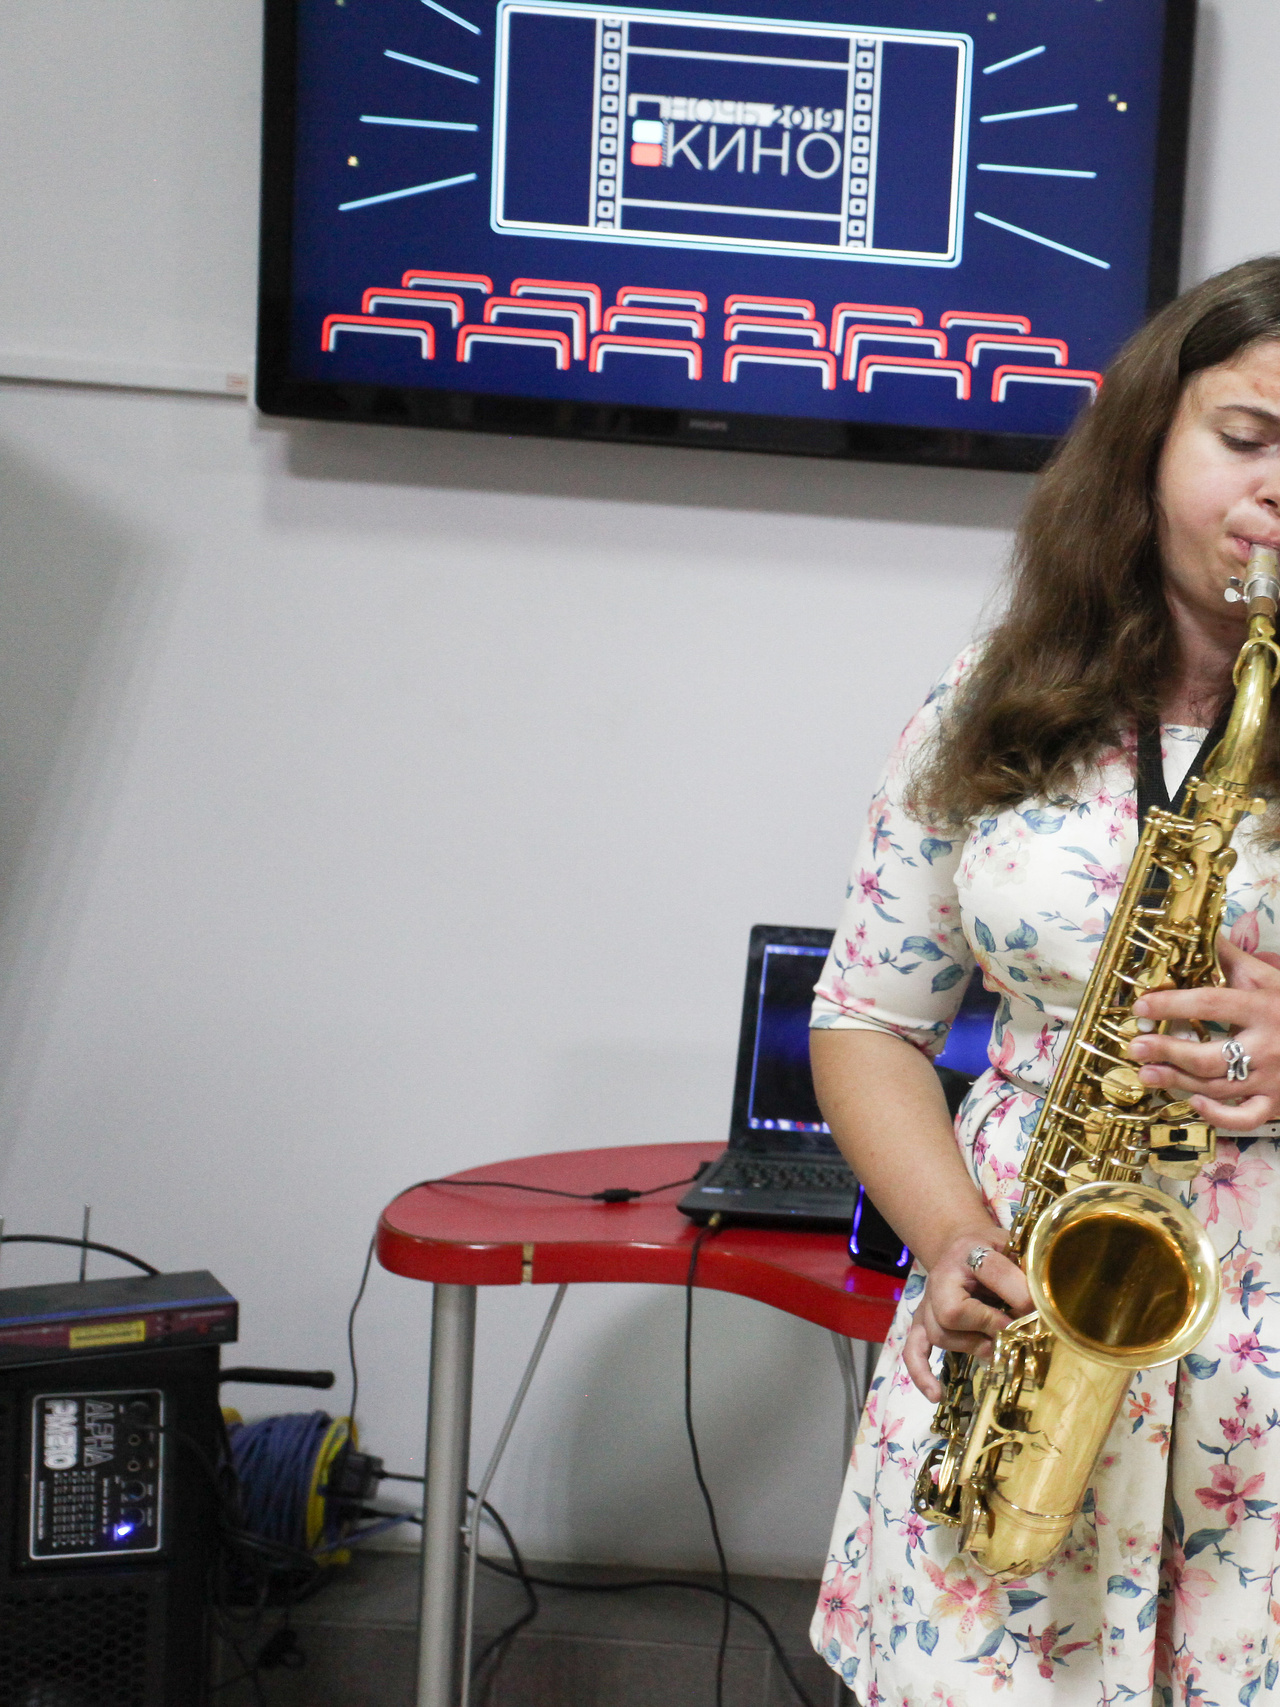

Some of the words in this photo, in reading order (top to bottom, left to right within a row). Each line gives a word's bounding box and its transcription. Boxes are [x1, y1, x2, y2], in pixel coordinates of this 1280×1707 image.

[669, 97, 760, 127] НОЧЬ
[771, 103, 840, 132] 2019
[665, 121, 842, 180] КИНО
[84, 1401, 114, 1467] ALPHA
